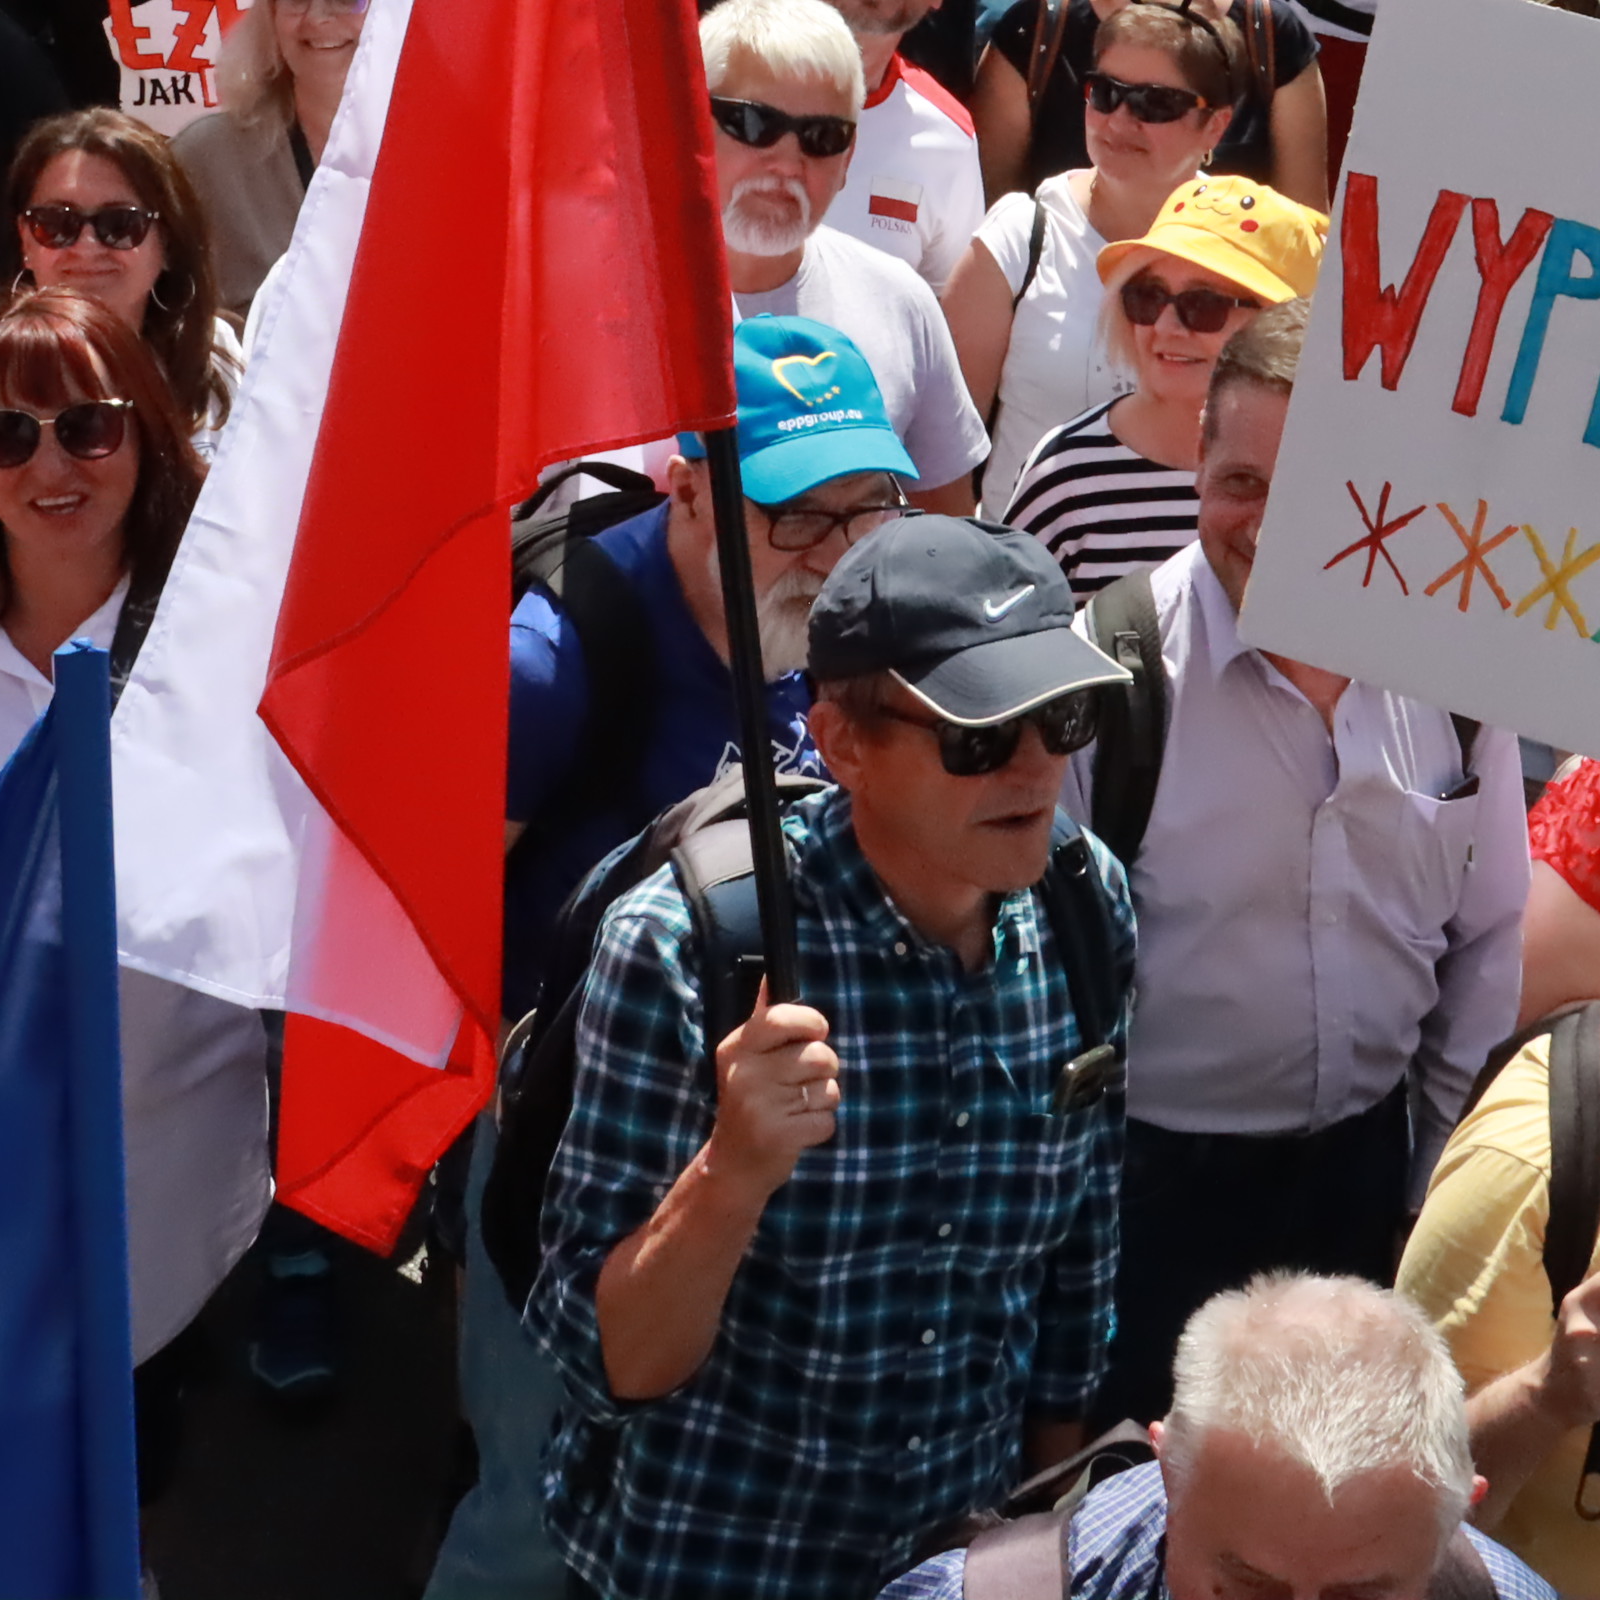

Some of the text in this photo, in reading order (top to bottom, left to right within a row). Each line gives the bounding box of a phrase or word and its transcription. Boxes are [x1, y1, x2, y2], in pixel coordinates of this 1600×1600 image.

[133, 74, 196, 106] JAK
[870, 217, 913, 234] POLSKA
[778, 408, 862, 432] eppgroup.eu
